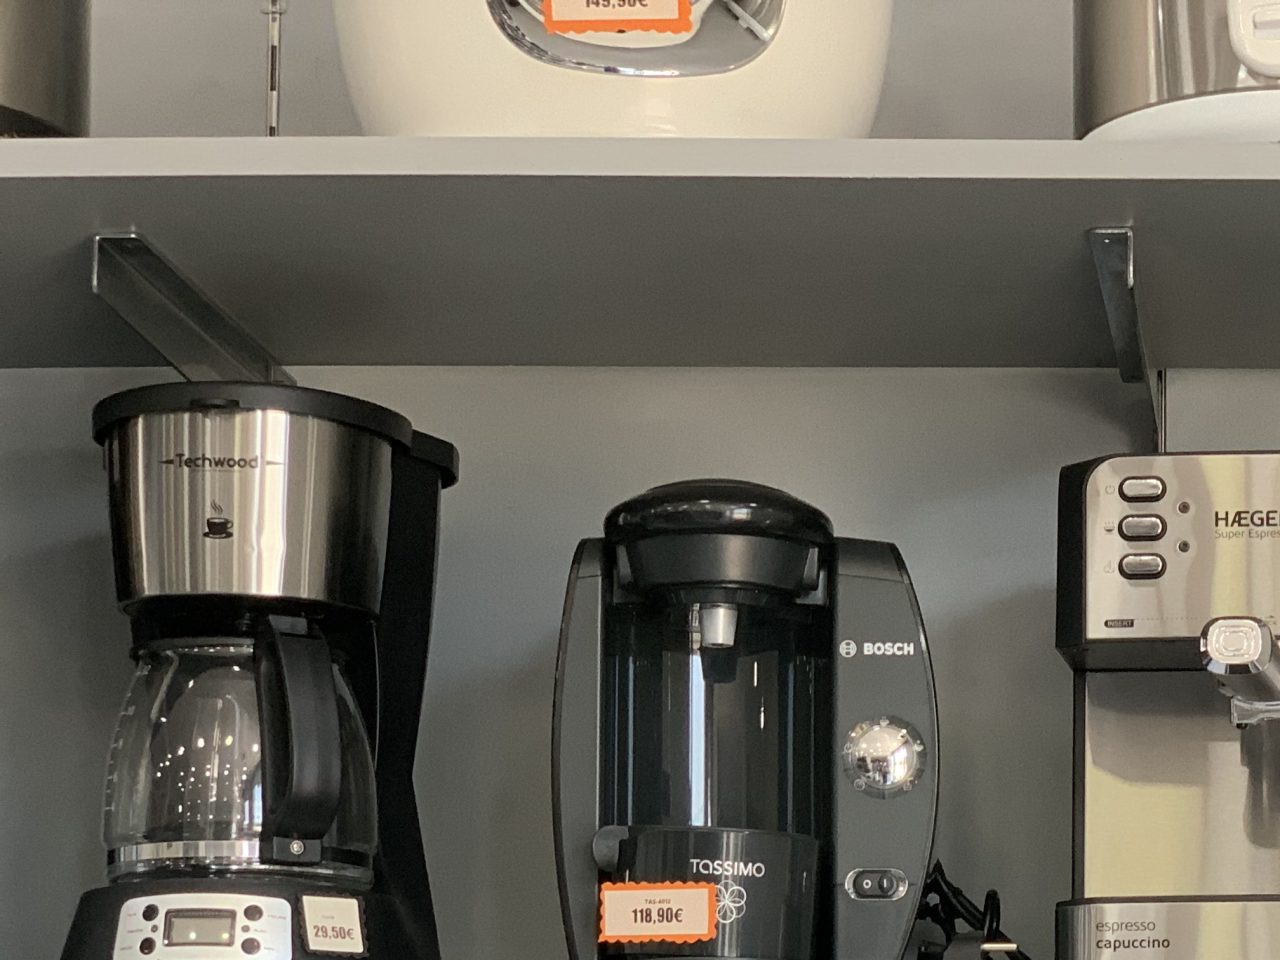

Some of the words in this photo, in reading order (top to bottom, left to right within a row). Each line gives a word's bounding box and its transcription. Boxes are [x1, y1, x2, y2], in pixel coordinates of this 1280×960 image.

[175, 453, 259, 469] Techwood
[1214, 529, 1245, 540] Super
[863, 642, 914, 655] BOSCH
[632, 907, 684, 925] 118,90€
[313, 924, 355, 940] 29,50€
[1095, 921, 1156, 935] espresso
[1095, 936, 1170, 952] capuccino
